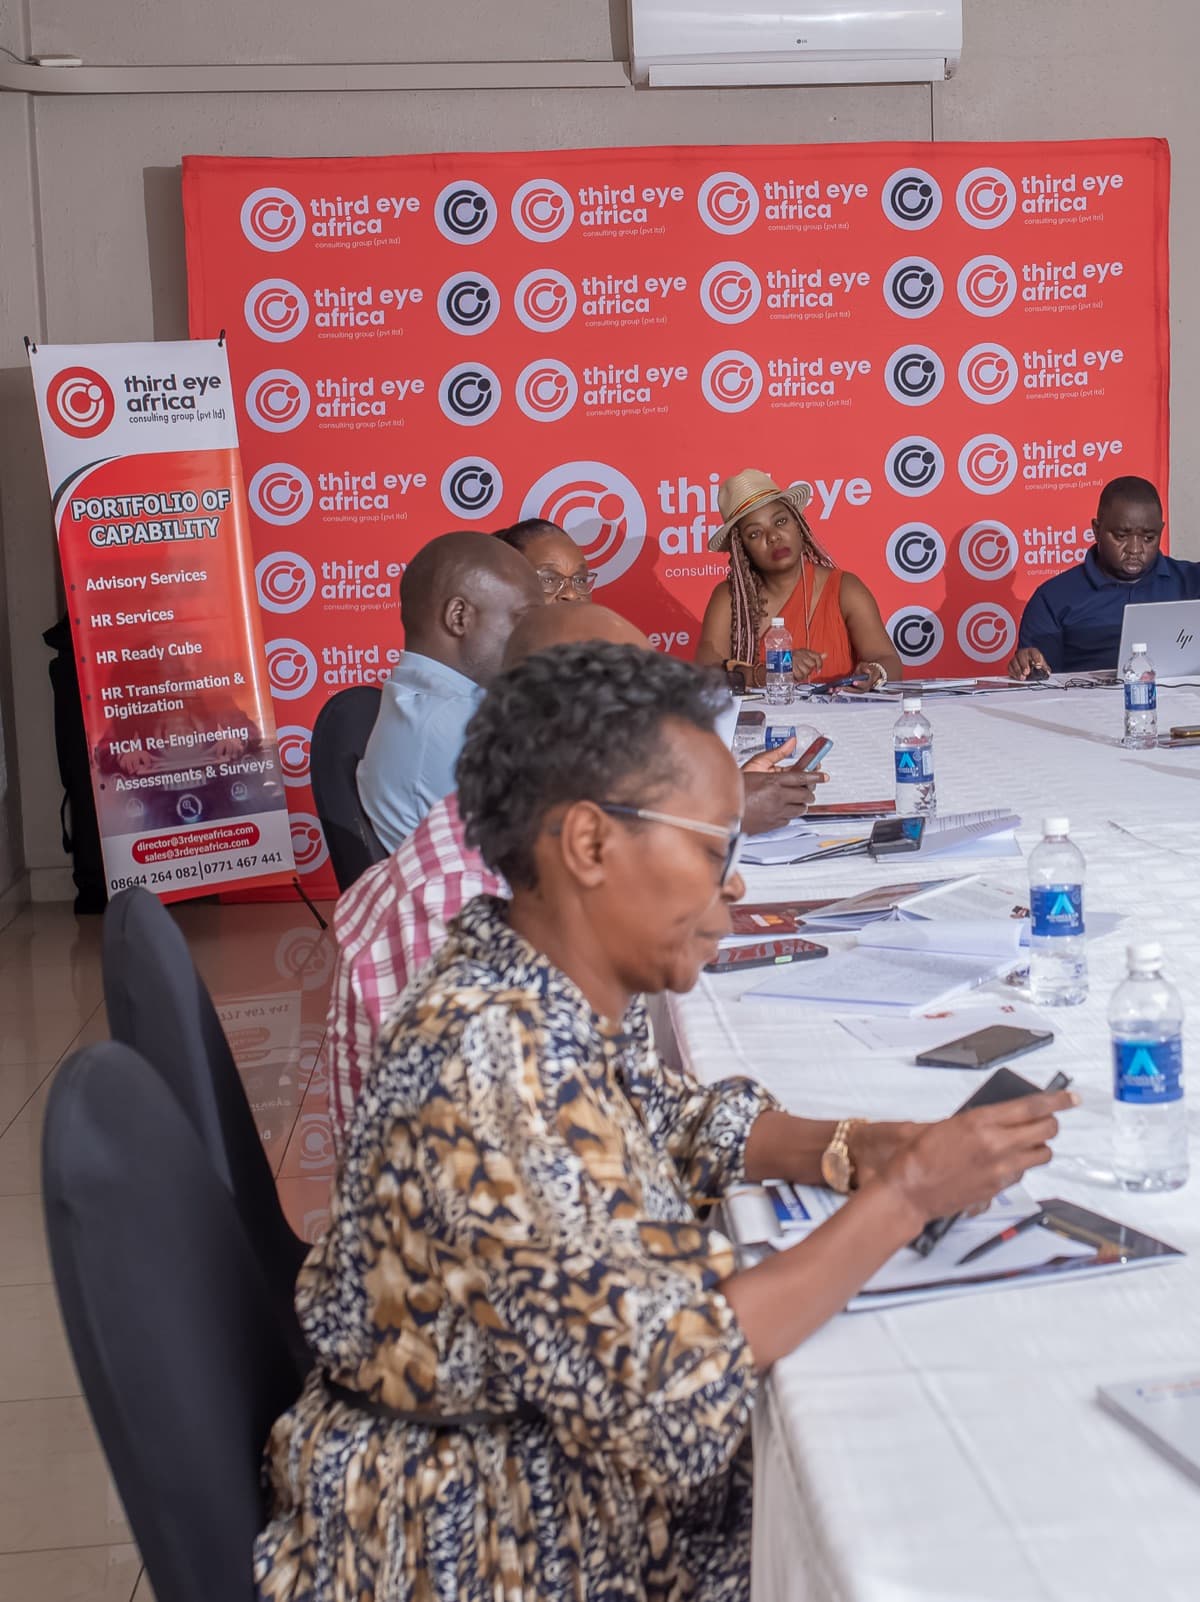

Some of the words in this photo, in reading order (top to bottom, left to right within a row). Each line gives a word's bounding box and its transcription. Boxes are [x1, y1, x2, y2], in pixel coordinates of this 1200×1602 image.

[763, 180, 819, 199] third
[826, 183, 868, 204] eye
[1021, 174, 1076, 193] third
[1082, 175, 1123, 196] eye
[310, 194, 369, 216] third
[376, 197, 420, 219] eye
[578, 185, 635, 205] third
[642, 186, 684, 208] eye
[1022, 193, 1087, 213] africa
[580, 205, 647, 225] africa
[765, 200, 831, 219] africa
[312, 216, 382, 237] africa
[766, 269, 822, 288] third
[828, 272, 870, 293] eye
[1022, 261, 1076, 281] third
[1082, 262, 1123, 283] eye
[313, 285, 372, 307] third
[379, 288, 423, 310] eye
[581, 275, 638, 295] third
[645, 276, 687, 298] eye
[1022, 281, 1087, 301] africa
[582, 295, 650, 315] africa
[767, 289, 833, 308] africa
[315, 307, 385, 327] africa
[767, 358, 823, 377] third
[830, 360, 871, 381] eye
[1022, 349, 1076, 368] third
[1083, 350, 1124, 371] eye
[124, 374, 177, 392] third
[182, 376, 222, 396] eye
[582, 364, 639, 384] third
[646, 366, 688, 387] eye
[768, 377, 834, 396] africa
[1024, 368, 1088, 388] africa
[315, 376, 374, 397] third
[381, 379, 425, 401] eye
[583, 385, 651, 405] africa
[127, 393, 196, 412] africa
[316, 397, 386, 417] africa
[129, 412, 168, 424] consulting
[172, 413, 194, 423] group
[1022, 440, 1076, 459] third
[1082, 441, 1123, 462] eye
[1023, 459, 1087, 479] africa
[317, 470, 376, 491] third
[383, 473, 427, 495] eye
[72, 492, 198, 520] PORTFOLIO
[202, 489, 230, 510] OF
[319, 491, 389, 511] africa
[90, 518, 219, 546] CAPABILITY
[1023, 526, 1076, 545] third
[1024, 545, 1088, 564] africa
[321, 559, 379, 579] third
[86, 576, 146, 592] Advisory
[150, 570, 207, 586] Services
[321, 580, 391, 599] africa
[90, 614, 112, 628] HR
[116, 610, 174, 626] Services
[96, 651, 118, 664] HR
[122, 646, 164, 662] Ready
[168, 642, 202, 656] Cube
[321, 644, 379, 664] third
[101, 687, 123, 700] HR
[126, 674, 230, 698] Transformation
[234, 672, 245, 684] &
[104, 698, 184, 720] Digitization
[109, 739, 142, 756] HCM
[146, 726, 248, 749] Re-Engineering
[115, 768, 202, 792] Assessments
[206, 766, 216, 778] &
[219, 758, 274, 778] Surveys
[137, 825, 254, 852] director@3rdeyeafrica.com
[144, 838, 250, 862] sales@3rdeyeafrica.com
[110, 874, 147, 890] 08644
[150, 870, 172, 884] 264
[236, 856, 258, 868] 467
[261, 852, 282, 864] 441
